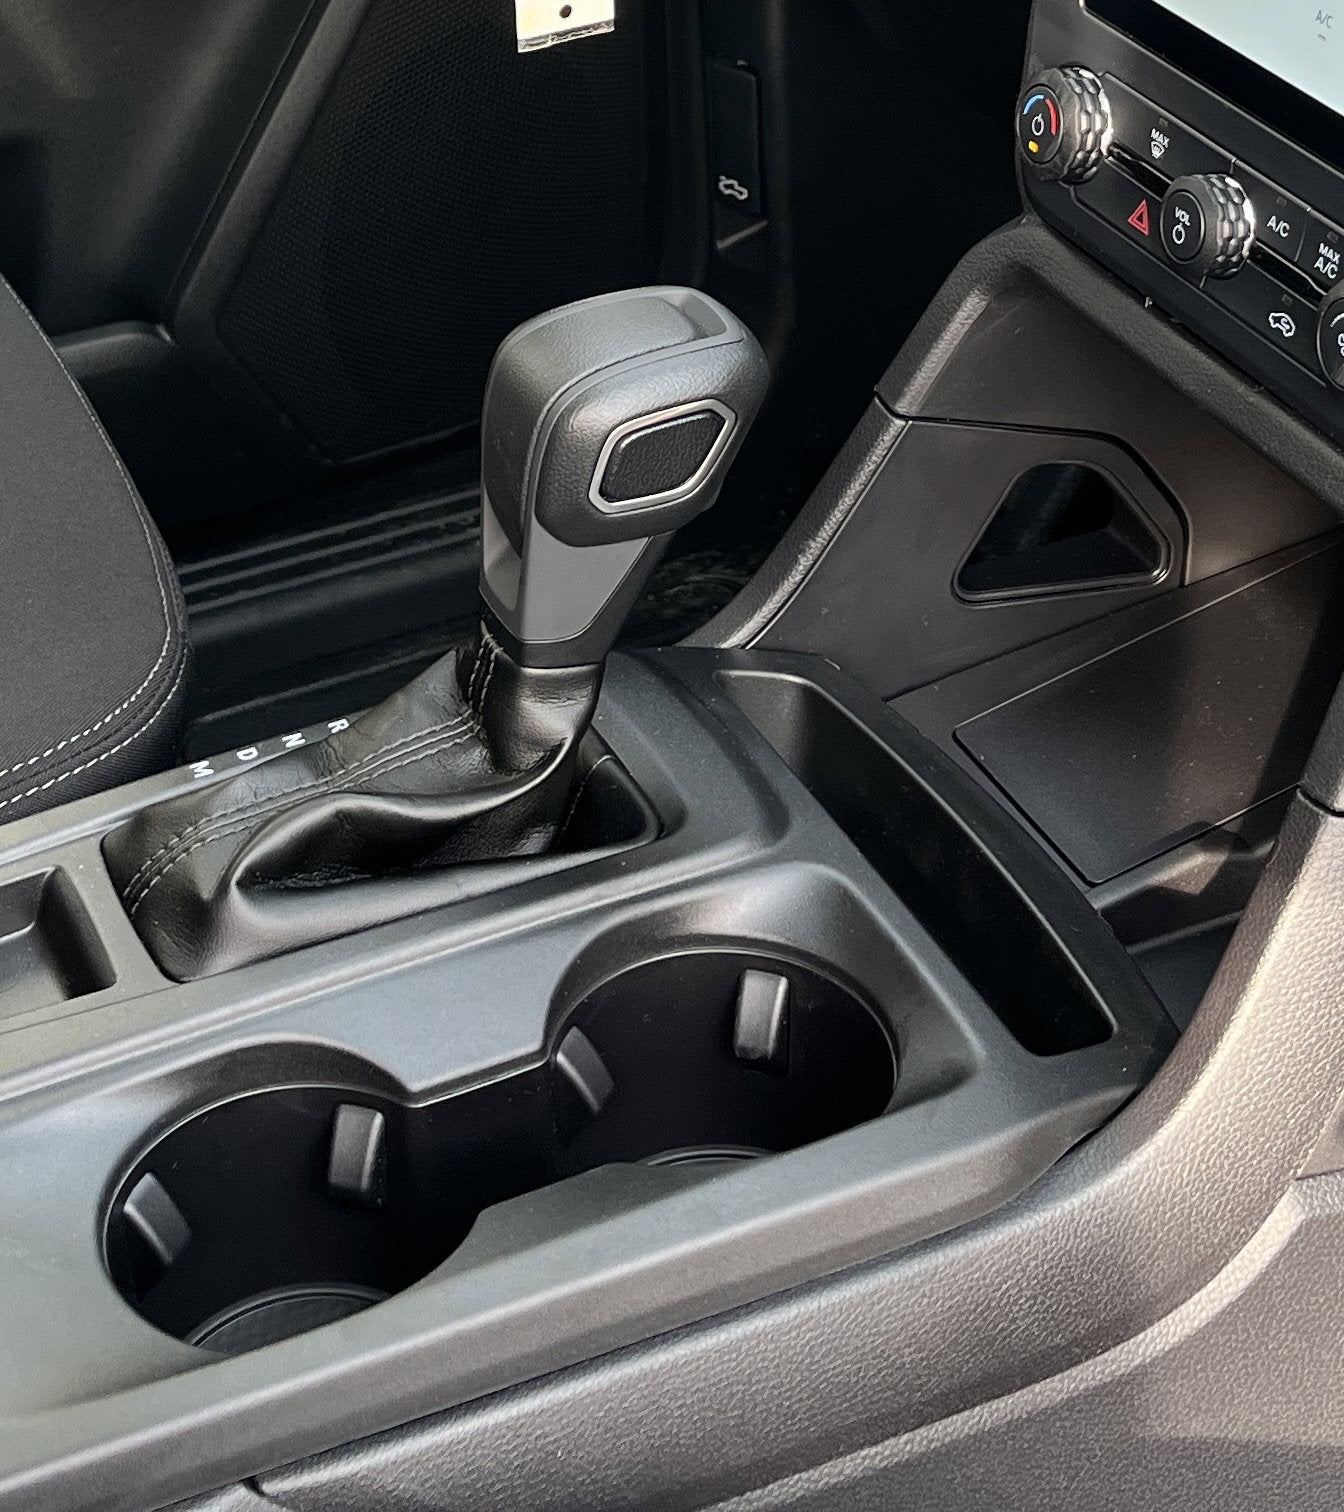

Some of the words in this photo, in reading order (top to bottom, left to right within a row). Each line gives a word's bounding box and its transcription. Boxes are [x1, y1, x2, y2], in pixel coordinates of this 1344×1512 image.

[1315, 9, 1334, 29] A/C
[1151, 128, 1170, 148] MAX
[1174, 206, 1190, 226] VOL
[1267, 215, 1290, 238] A/C
[1319, 242, 1340, 265] MAX
[1314, 257, 1338, 279] A/C
[327, 719, 349, 734] R
[282, 732, 306, 749] N
[236, 746, 259, 762] D
[188, 760, 215, 779] M
